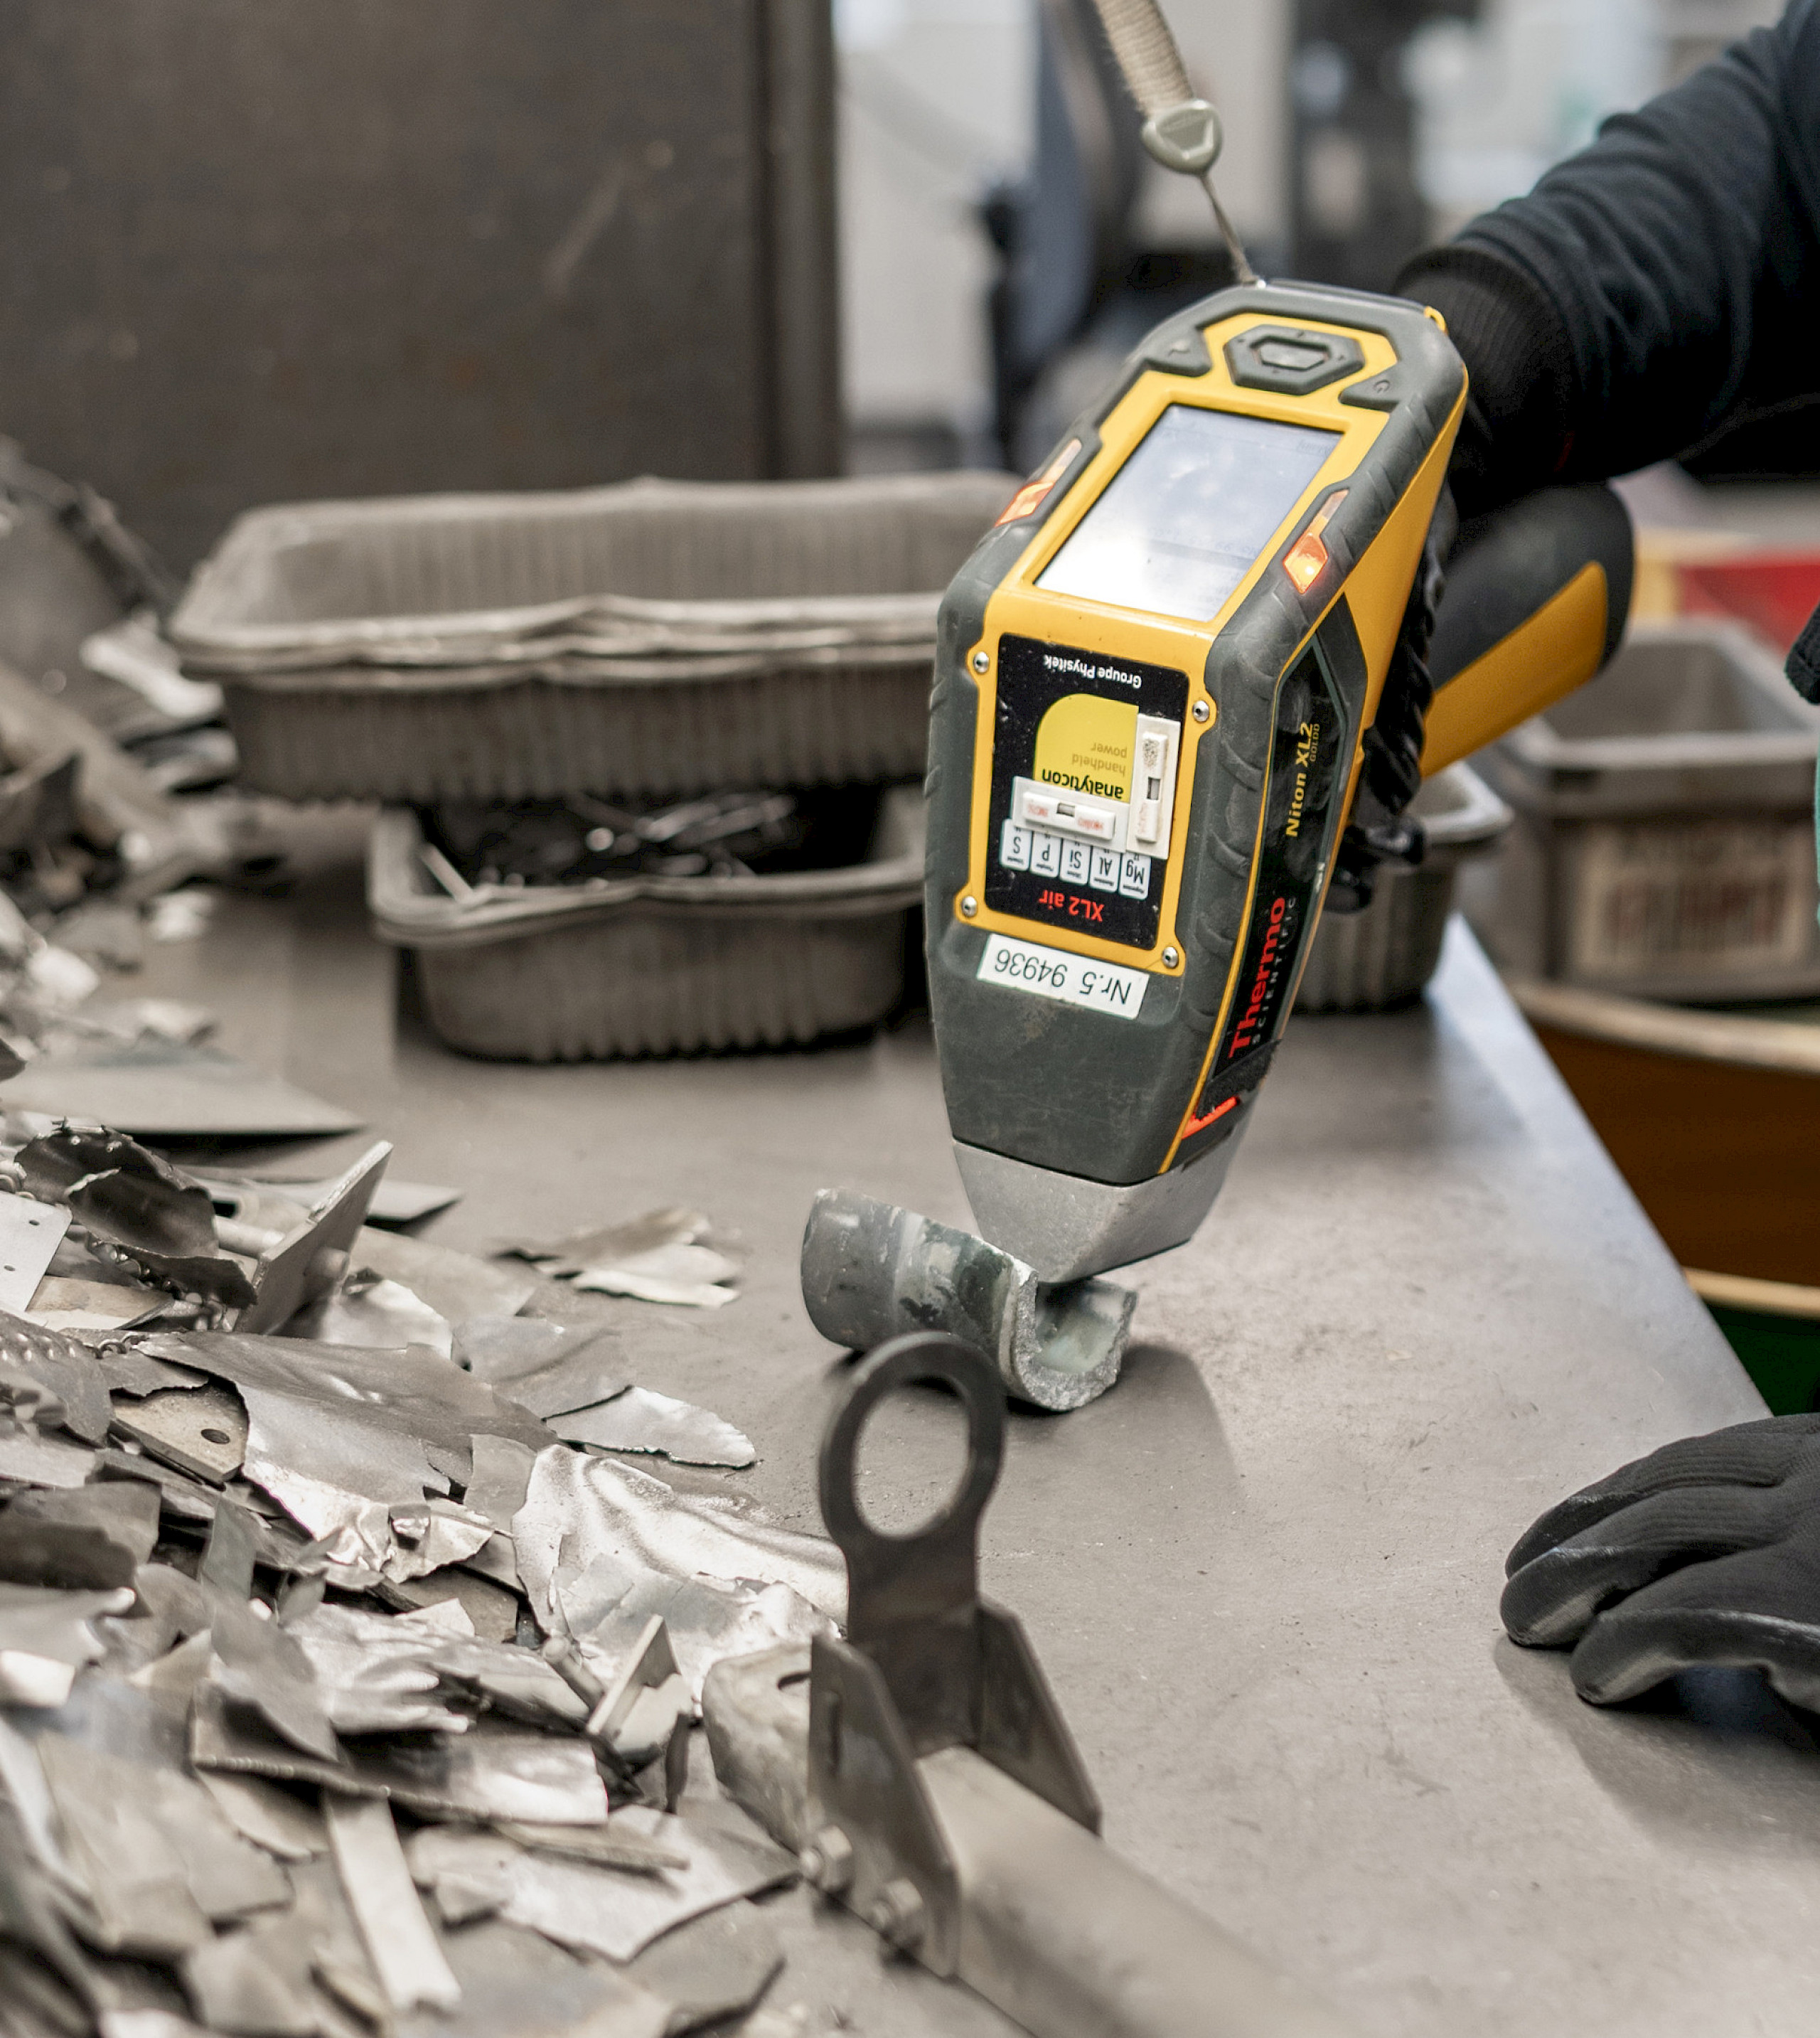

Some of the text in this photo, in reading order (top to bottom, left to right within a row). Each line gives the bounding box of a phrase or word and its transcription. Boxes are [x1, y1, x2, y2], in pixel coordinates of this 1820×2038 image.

[1043, 654, 1142, 689] Groupe Physitek
[1091, 742, 1128, 759] power
[1309, 723, 1321, 762] GOLDD
[1071, 753, 1126, 777] handheld
[1285, 722, 1313, 837] Niton XL2
[1042, 769, 1123, 799] analyticon
[1013, 836, 1022, 853] S
[1042, 843, 1050, 861] P
[1070, 850, 1081, 868] Si
[1099, 857, 1112, 875] Al
[1126, 859, 1145, 884] Mg
[1039, 889, 1104, 922] XL2 air
[995, 949, 1132, 1005] Nr.5 94936
[1228, 897, 1286, 1058] Thermo
[1252, 897, 1296, 1044] SCIENTIFIC
